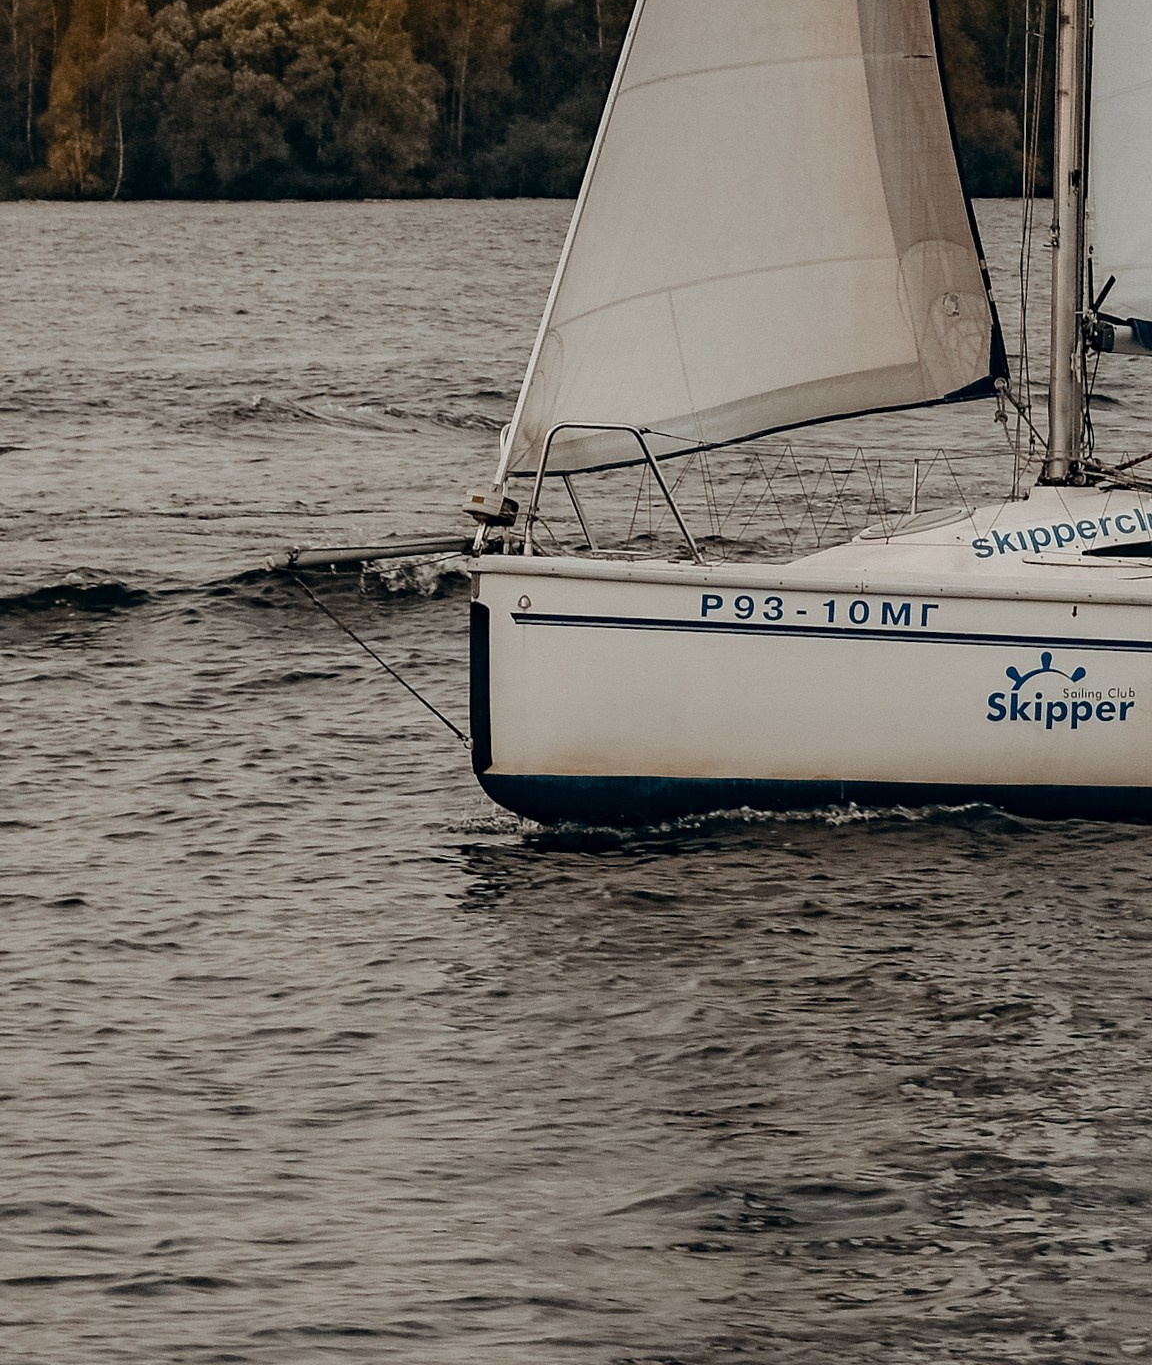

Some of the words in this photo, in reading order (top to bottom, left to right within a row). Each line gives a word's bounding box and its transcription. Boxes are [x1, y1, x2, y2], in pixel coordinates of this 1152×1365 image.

[1063, 687, 1103, 702] Sailing
[1107, 687, 1136, 699] Club
[986, 691, 1135, 730] Skipper
